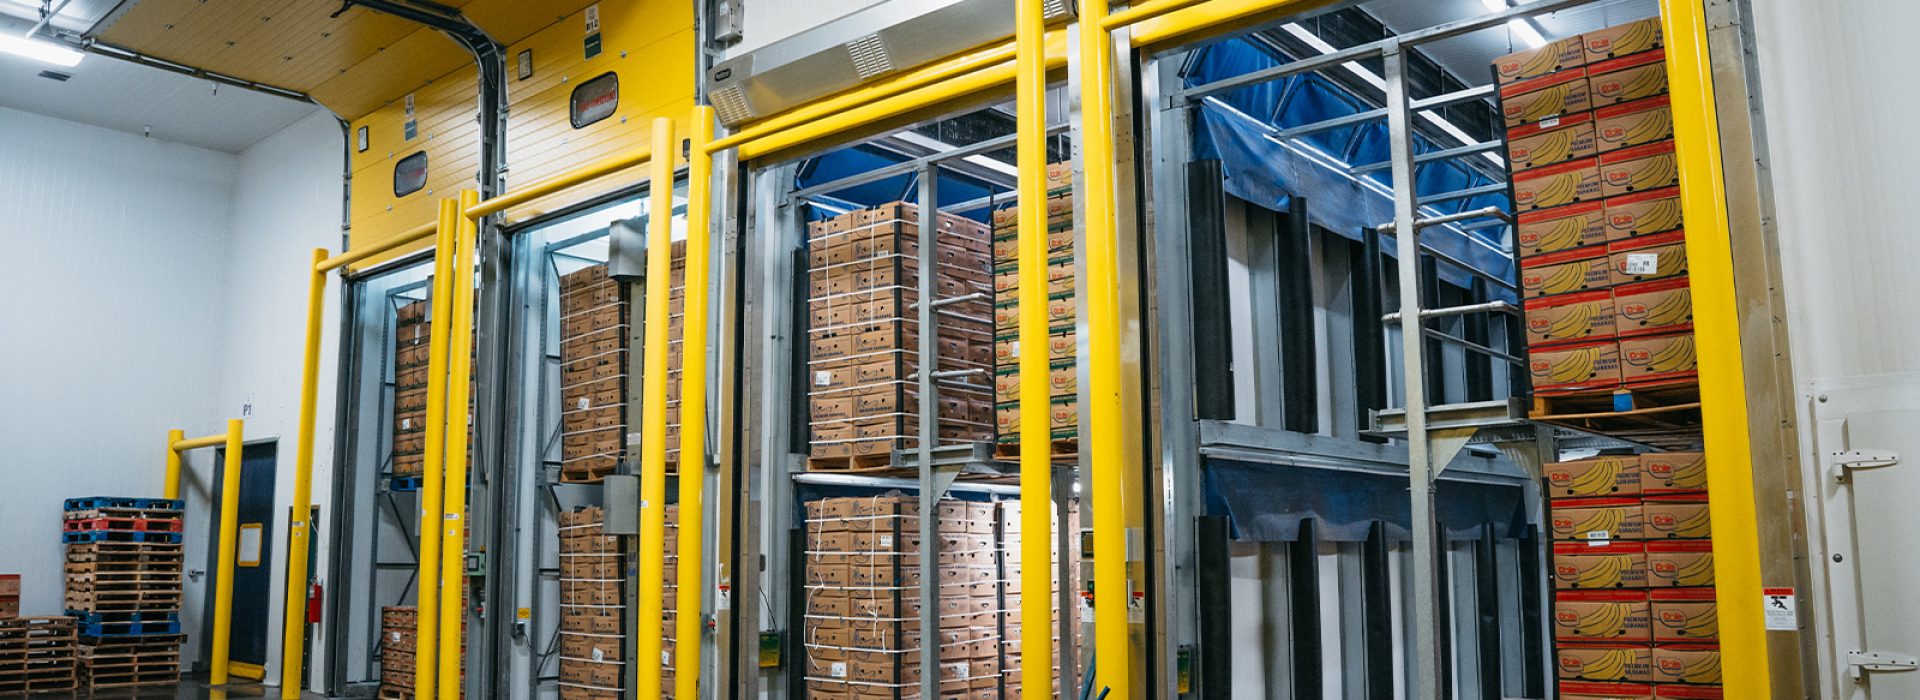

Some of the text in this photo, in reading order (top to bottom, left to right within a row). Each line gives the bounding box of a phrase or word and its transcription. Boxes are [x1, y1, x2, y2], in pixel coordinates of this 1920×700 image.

[1591, 38, 1609, 48] Dole
[1502, 62, 1519, 73] Dole
[1601, 82, 1620, 93] Dole
[1505, 105, 1521, 114] Dole
[1604, 127, 1623, 137] Dole
[1511, 149, 1528, 158] Dole
[1609, 171, 1628, 181] Dole
[1516, 191, 1533, 200] Dole
[1613, 215, 1632, 224] Dole
[1520, 233, 1538, 242] Dole
[1524, 276, 1541, 284] Dole
[1626, 305, 1645, 313] Dole
[1531, 319, 1548, 327] Dole
[1629, 351, 1648, 359] Dole
[1532, 362, 1549, 370] Dole
[1651, 464, 1671, 472] Dole
[1552, 473, 1570, 481] Dole
[1554, 519, 1572, 527] Dole
[1654, 516, 1673, 524] Dole
[1558, 566, 1576, 574] Dole
[1655, 563, 1675, 571] Dole
[1558, 612, 1577, 620] Dole
[1663, 612, 1682, 620] Dole
[1661, 659, 1680, 668] Dole
